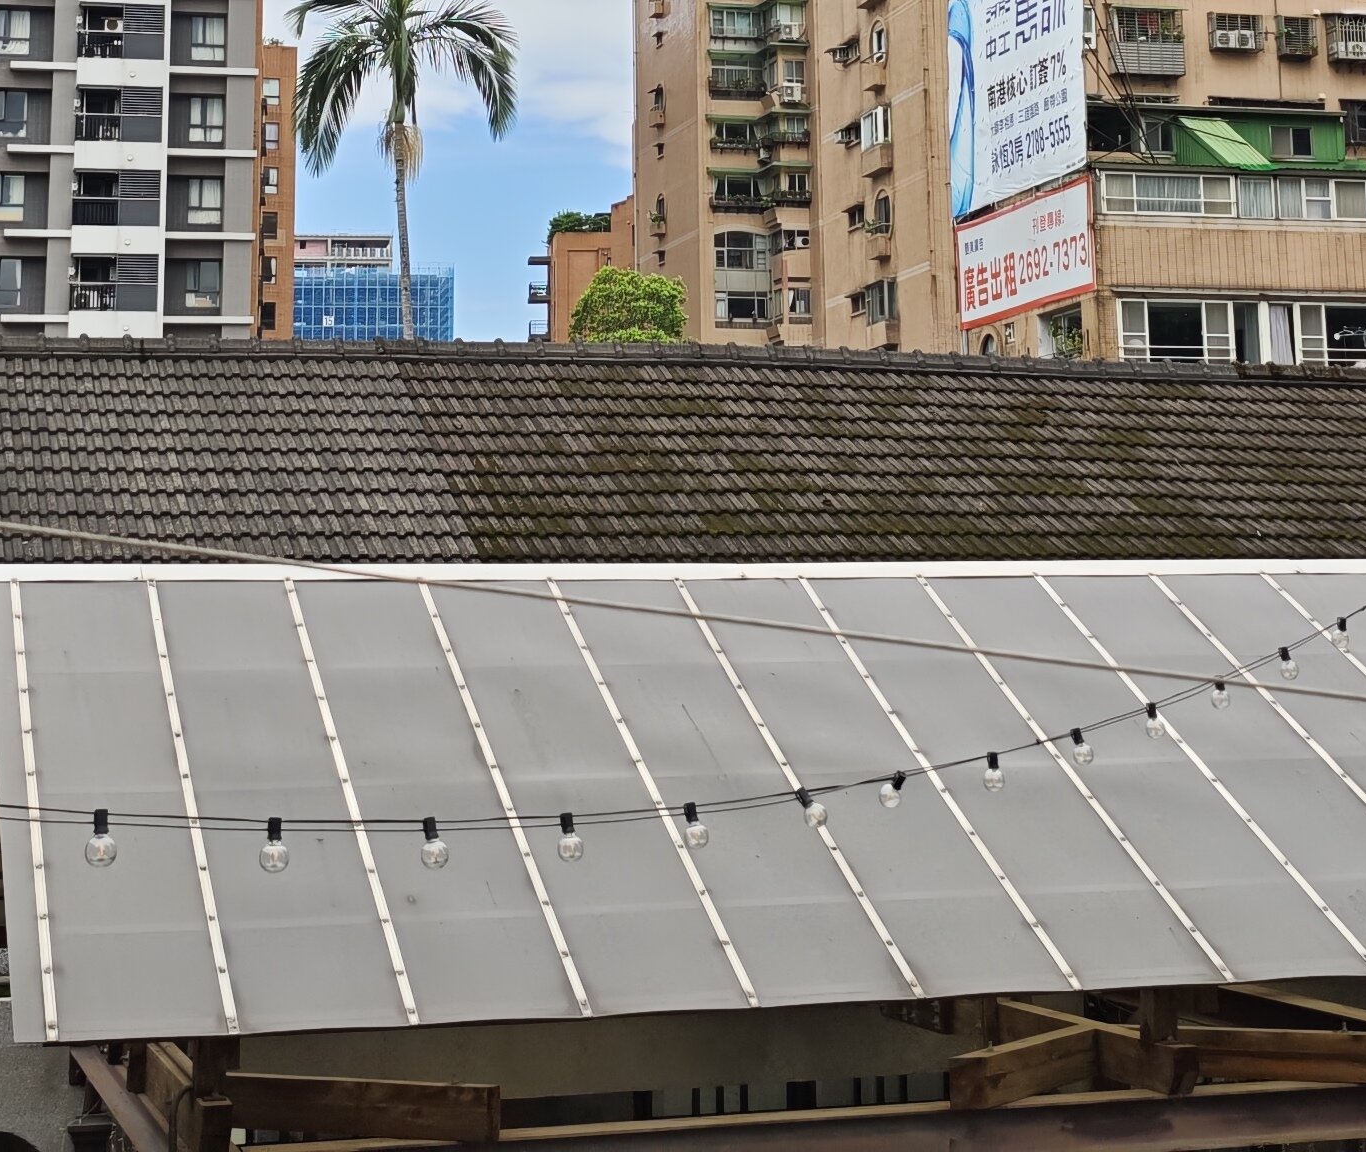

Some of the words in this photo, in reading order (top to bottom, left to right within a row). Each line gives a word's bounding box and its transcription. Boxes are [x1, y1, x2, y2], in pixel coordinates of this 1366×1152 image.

[987, 70, 1028, 112] 南港核心
[1050, 49, 1067, 81] 7%
[1025, 115, 1071, 159] 2788-5555
[964, 252, 1017, 312] 廣告出租
